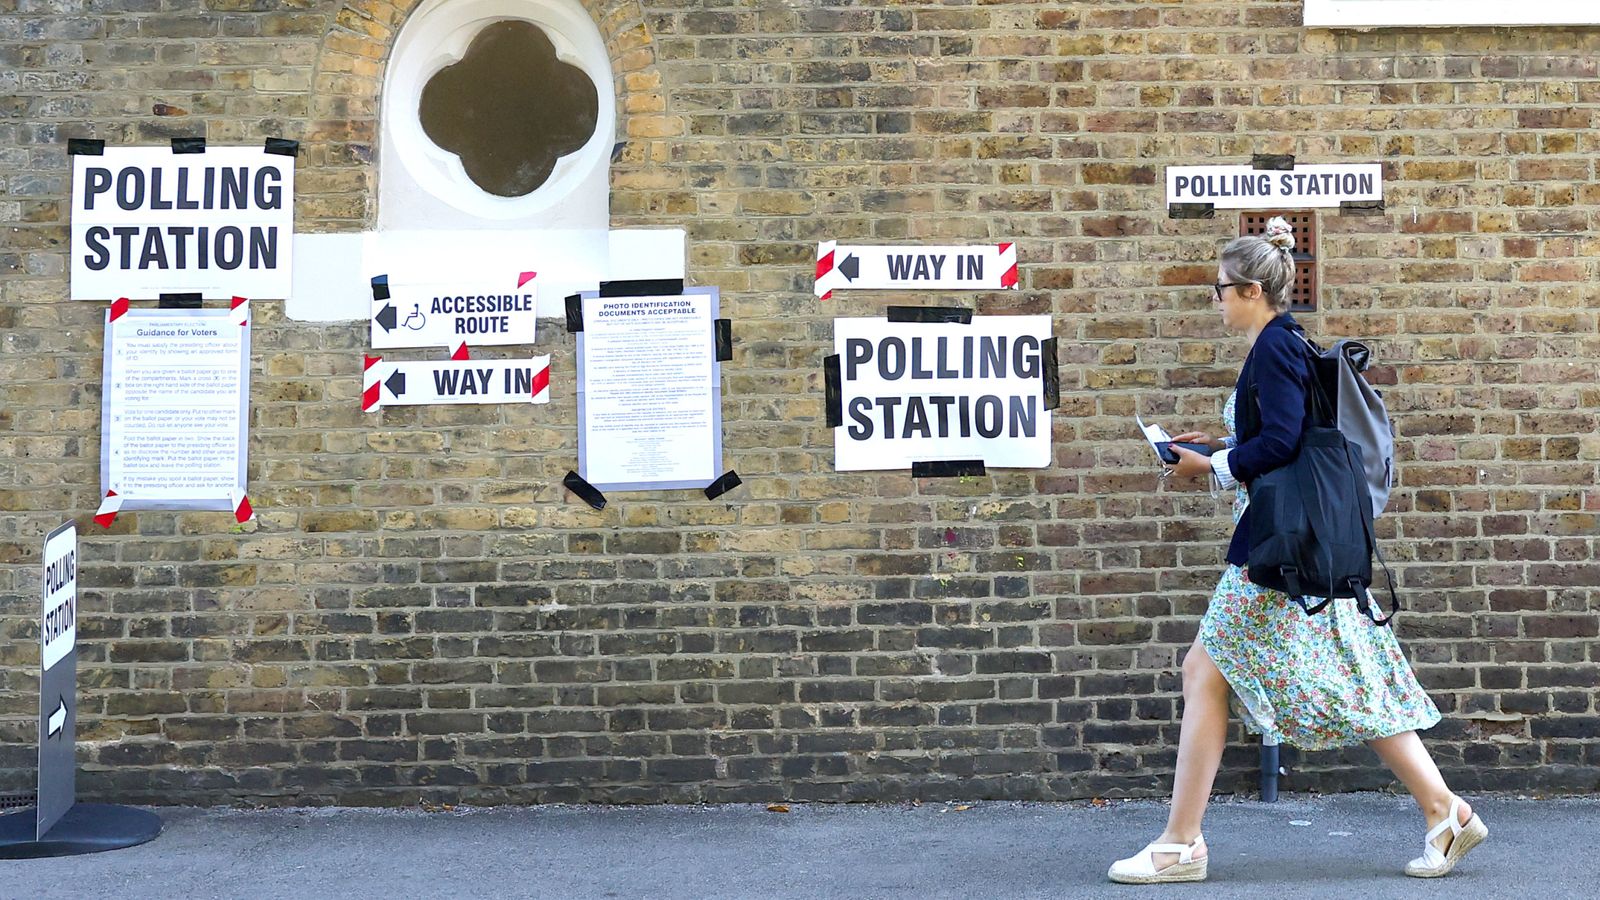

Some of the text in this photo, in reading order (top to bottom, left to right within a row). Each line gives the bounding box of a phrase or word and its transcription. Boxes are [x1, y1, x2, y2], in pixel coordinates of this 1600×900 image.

[84, 166, 282, 211] POLLING
[1175, 173, 1373, 197] POLLING STATION
[84, 226, 278, 271] STATION
[887, 254, 984, 280] WAY IN
[431, 294, 533, 314] ACCESSIBLE
[598, 307, 697, 317] DOCUMENTS ACCEPTABLE
[631, 300, 692, 309] IDENTIFICATION
[455, 316, 509, 334] ROUTE
[846, 335, 1040, 381] POLLING
[433, 368, 532, 395] WAY IN
[848, 395, 1037, 441] STATION
[46, 549, 75, 599] POLLING
[45, 595, 74, 647] STATION
